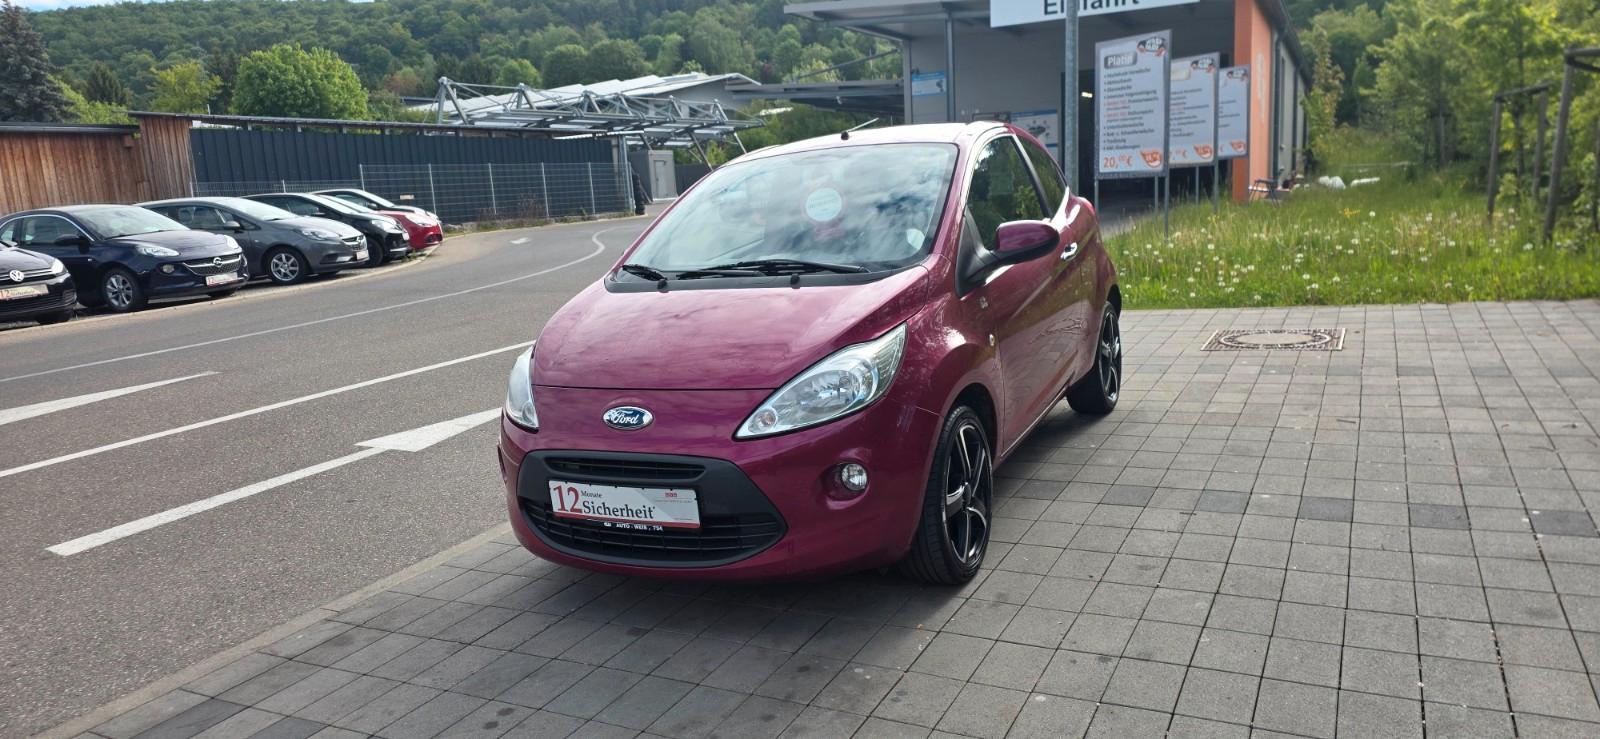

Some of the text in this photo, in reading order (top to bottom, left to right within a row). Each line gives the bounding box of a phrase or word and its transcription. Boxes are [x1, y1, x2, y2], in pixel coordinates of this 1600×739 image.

[1044, 0, 1140, 15] Eifa
[1107, 55, 1133, 67] Platin
[611, 410, 640, 425] Ford
[553, 484, 603, 514] 12 Monate
[582, 500, 656, 519] Sicherheit
